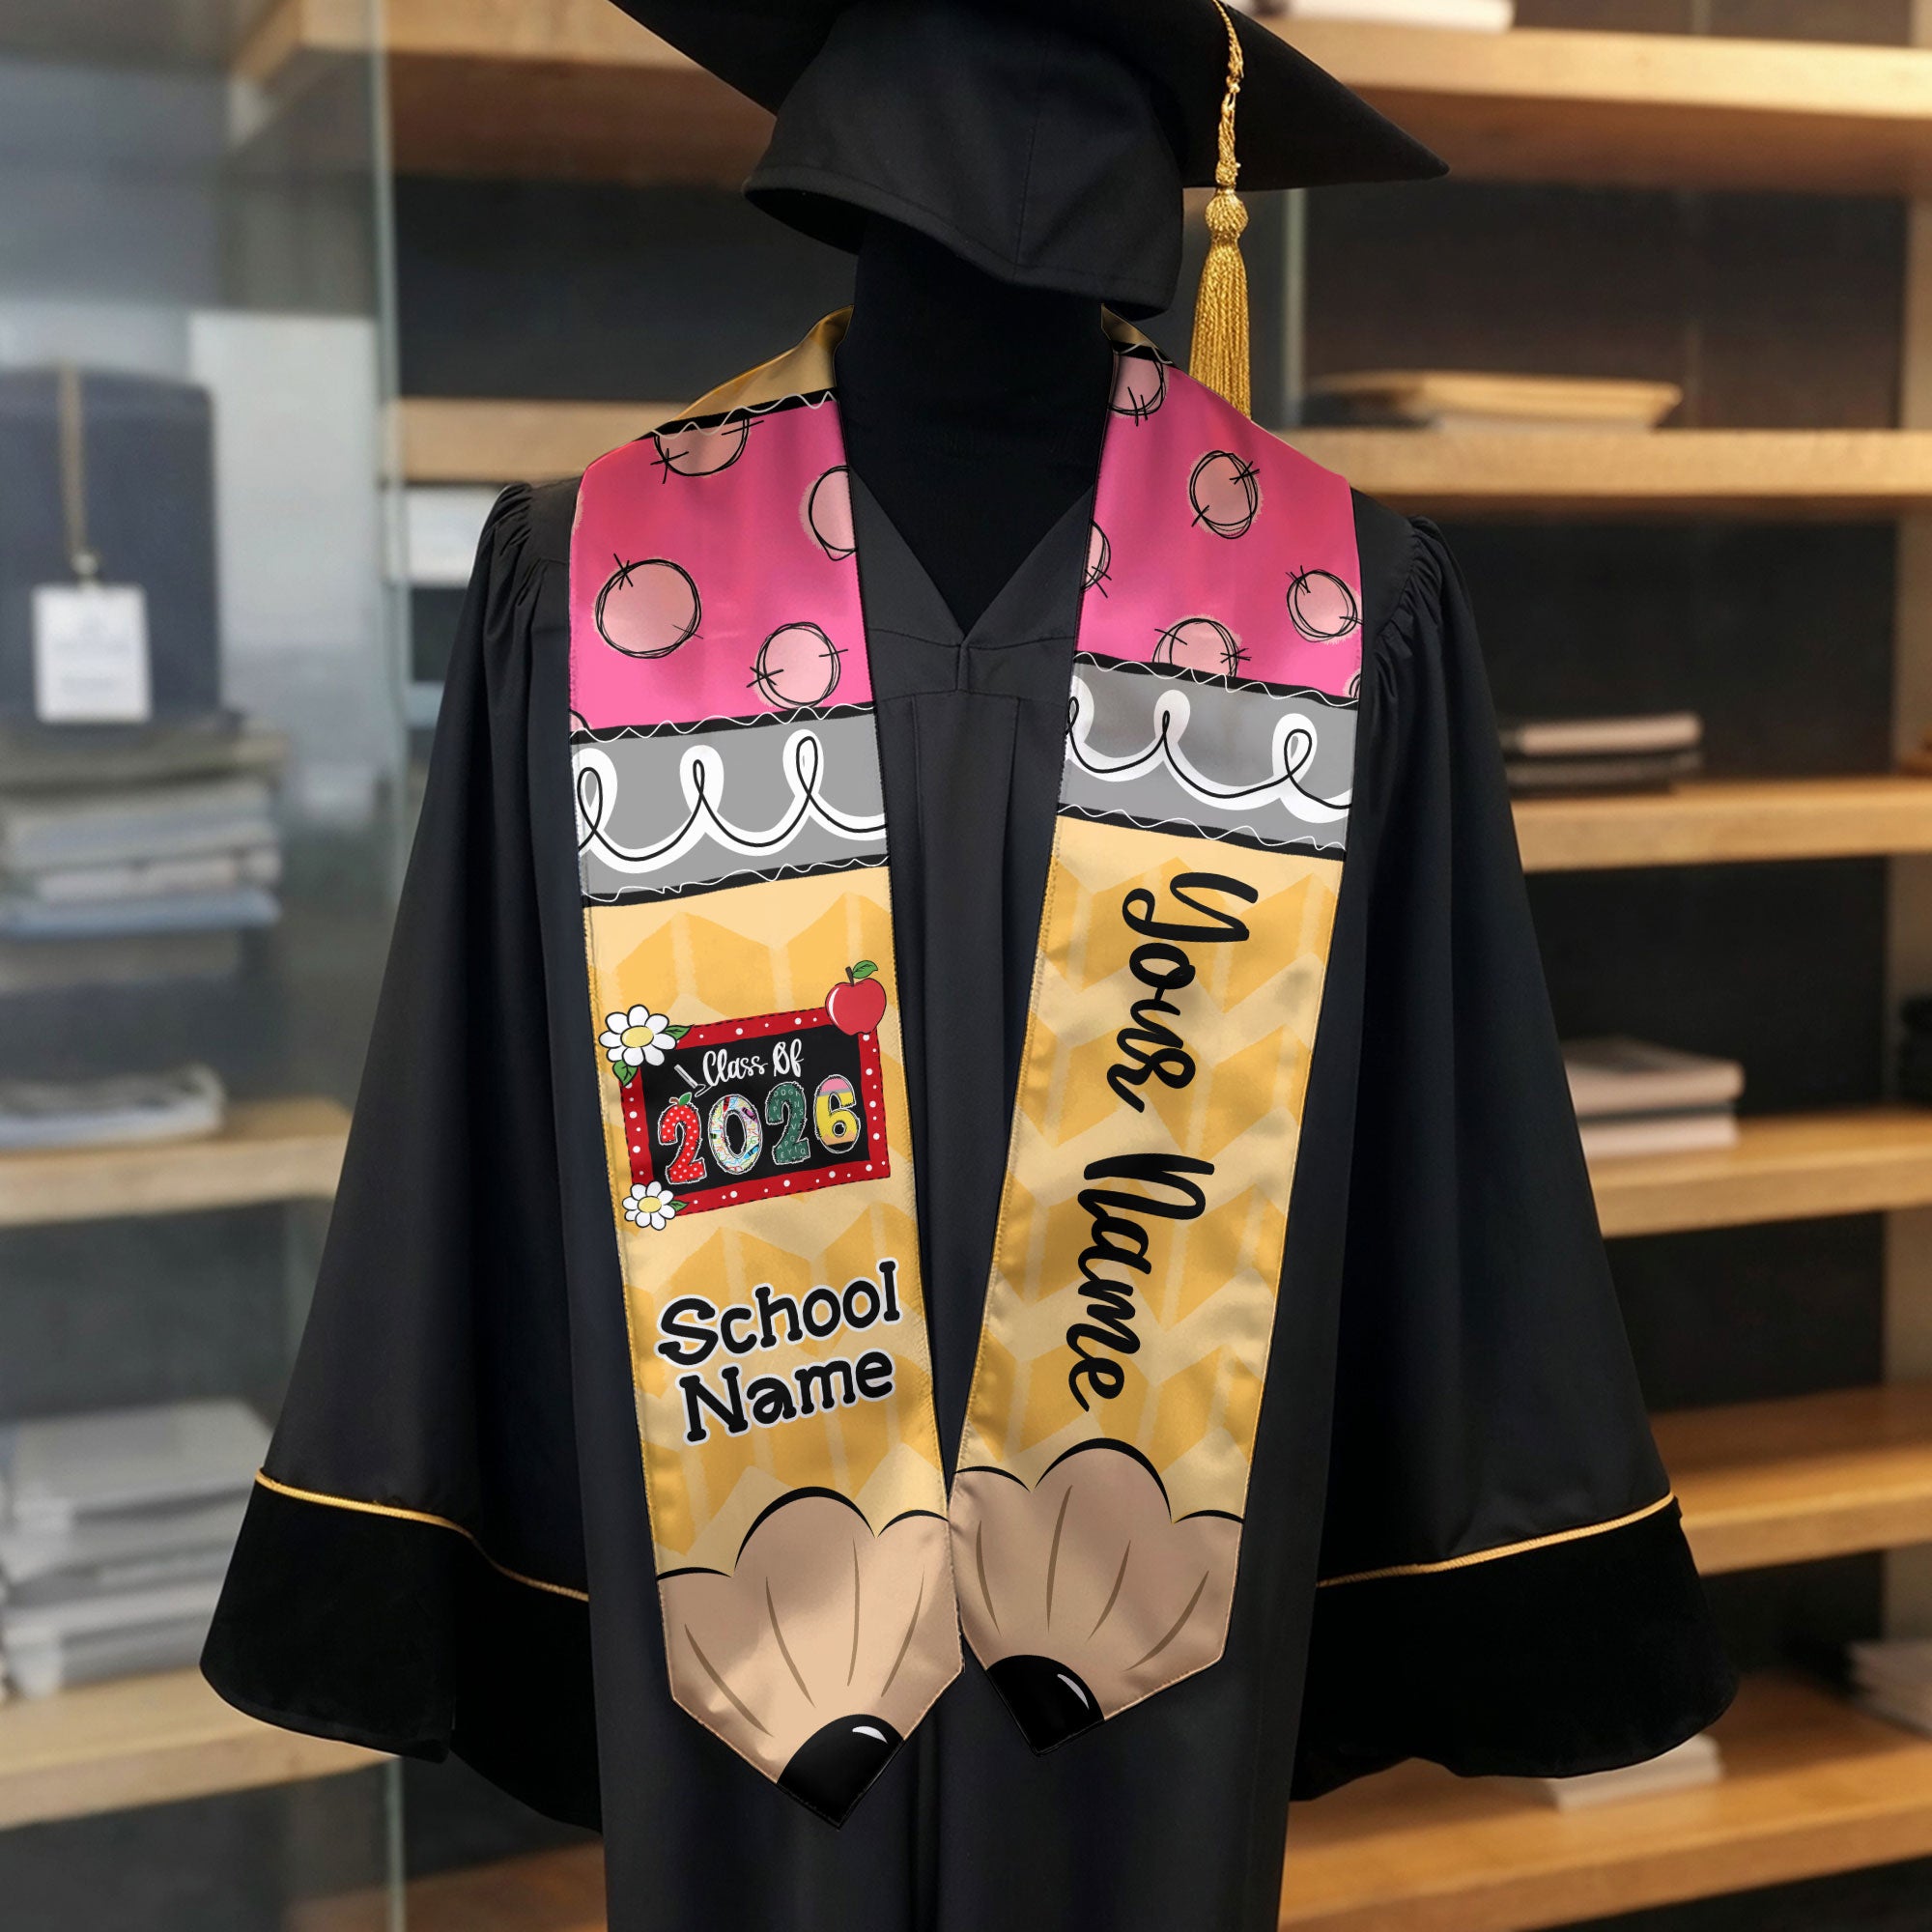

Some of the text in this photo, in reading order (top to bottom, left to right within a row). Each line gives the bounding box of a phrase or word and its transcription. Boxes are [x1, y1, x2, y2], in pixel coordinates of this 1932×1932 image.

[702, 1037, 805, 1087] Class Of
[657, 1073, 862, 1185] 2026
[1065, 871, 1259, 1412] Your Name
[656, 1259, 902, 1367] School
[677, 1349, 895, 1443] Name
